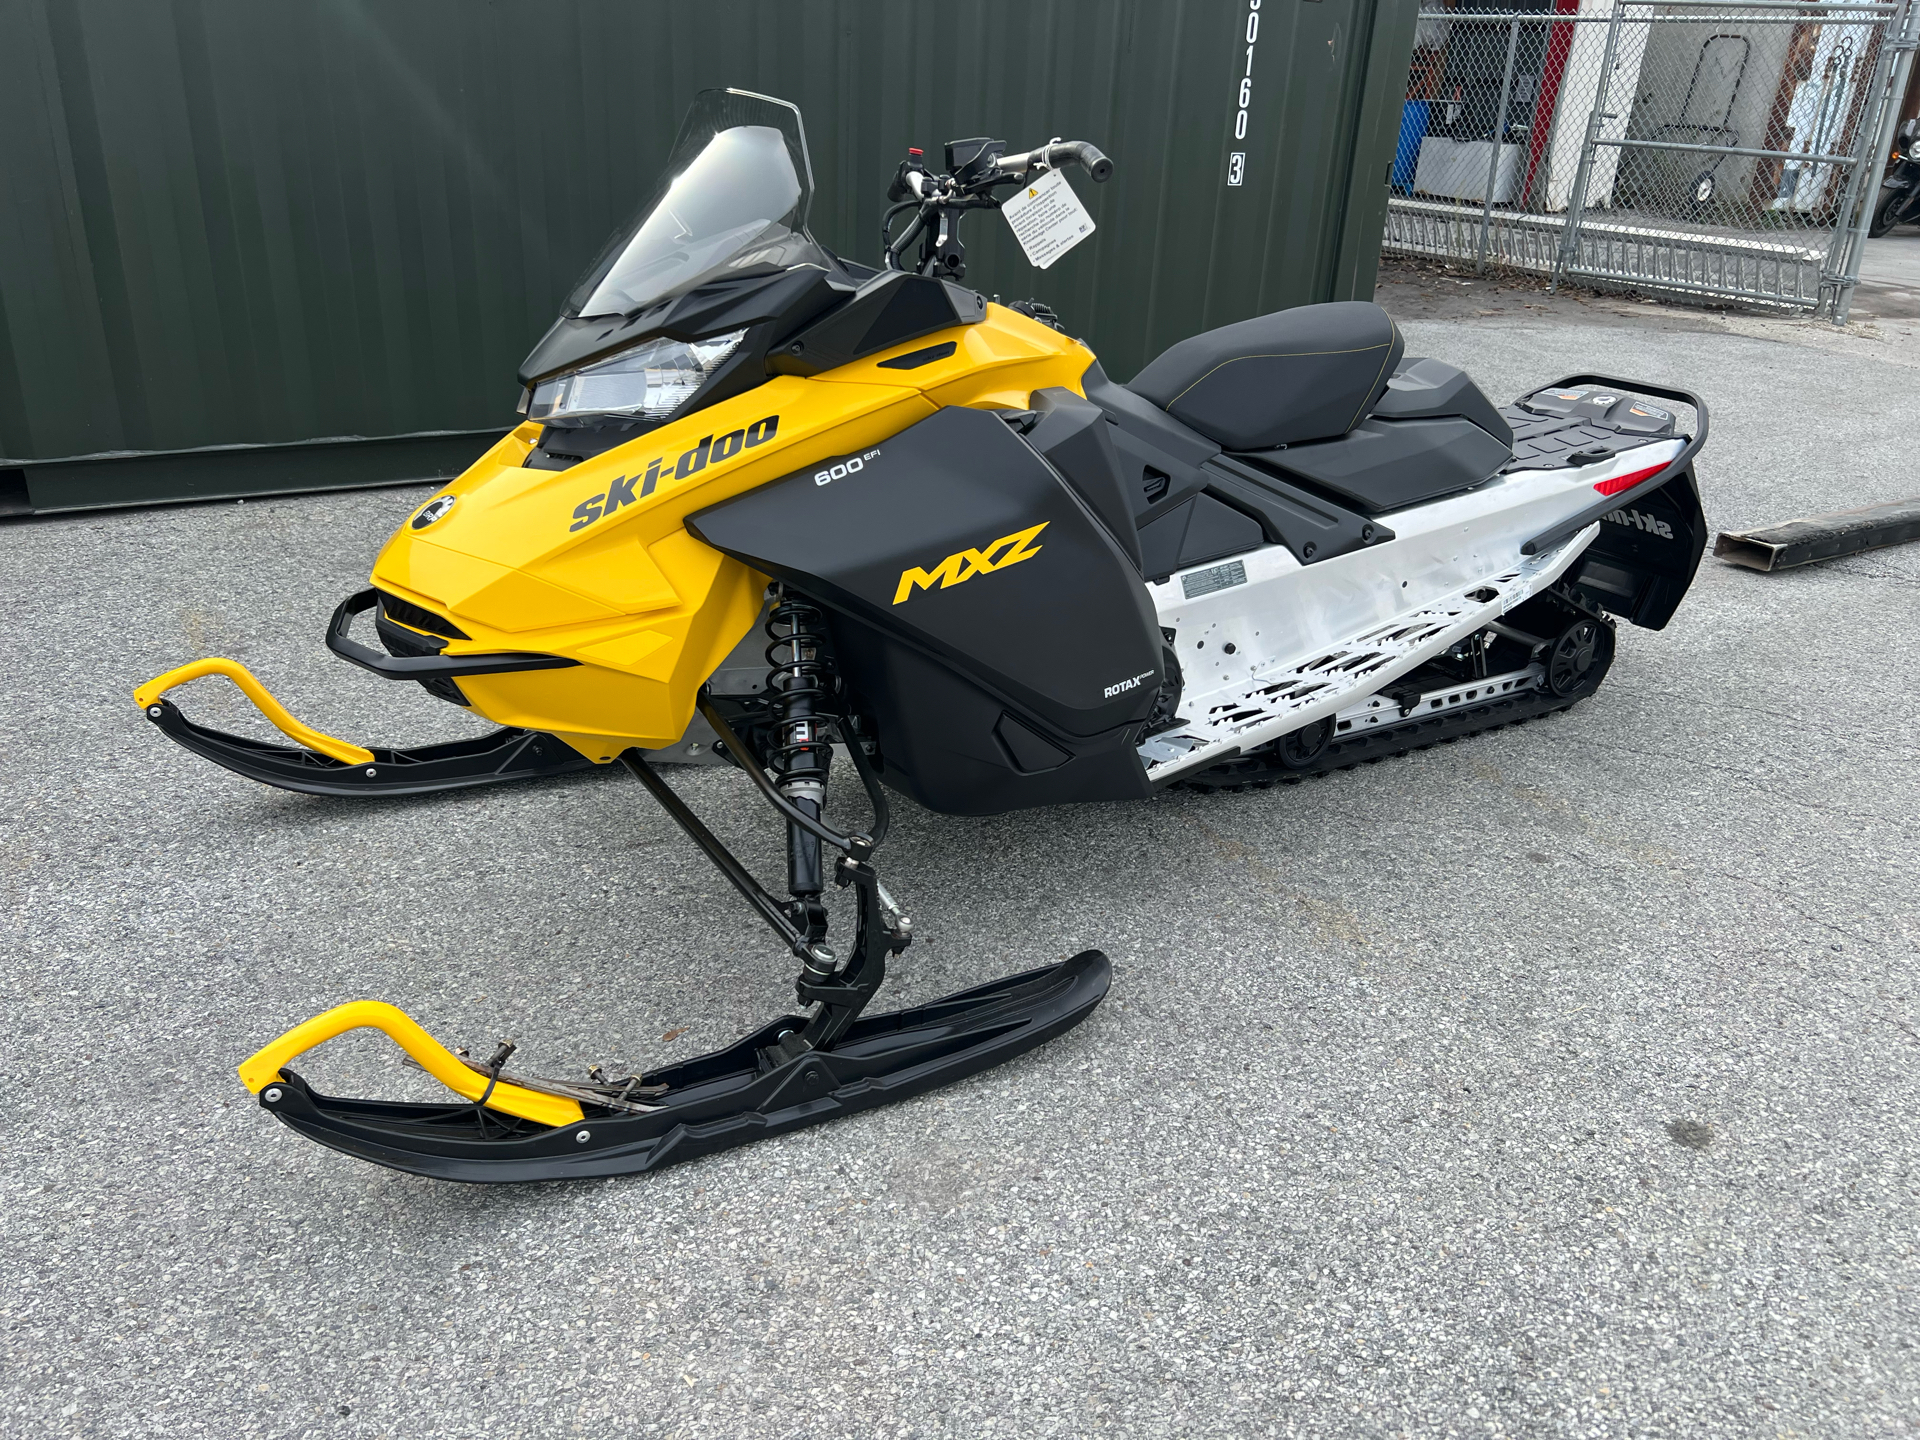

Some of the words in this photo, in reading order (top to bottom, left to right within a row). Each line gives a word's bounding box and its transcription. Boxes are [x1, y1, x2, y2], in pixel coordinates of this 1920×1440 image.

[1229, 153, 1244, 184] 3
[814, 457, 864, 486] 600
[863, 449, 882, 461] EFI
[892, 520, 1051, 606] MXZ
[1104, 675, 1141, 699] ROTAX
